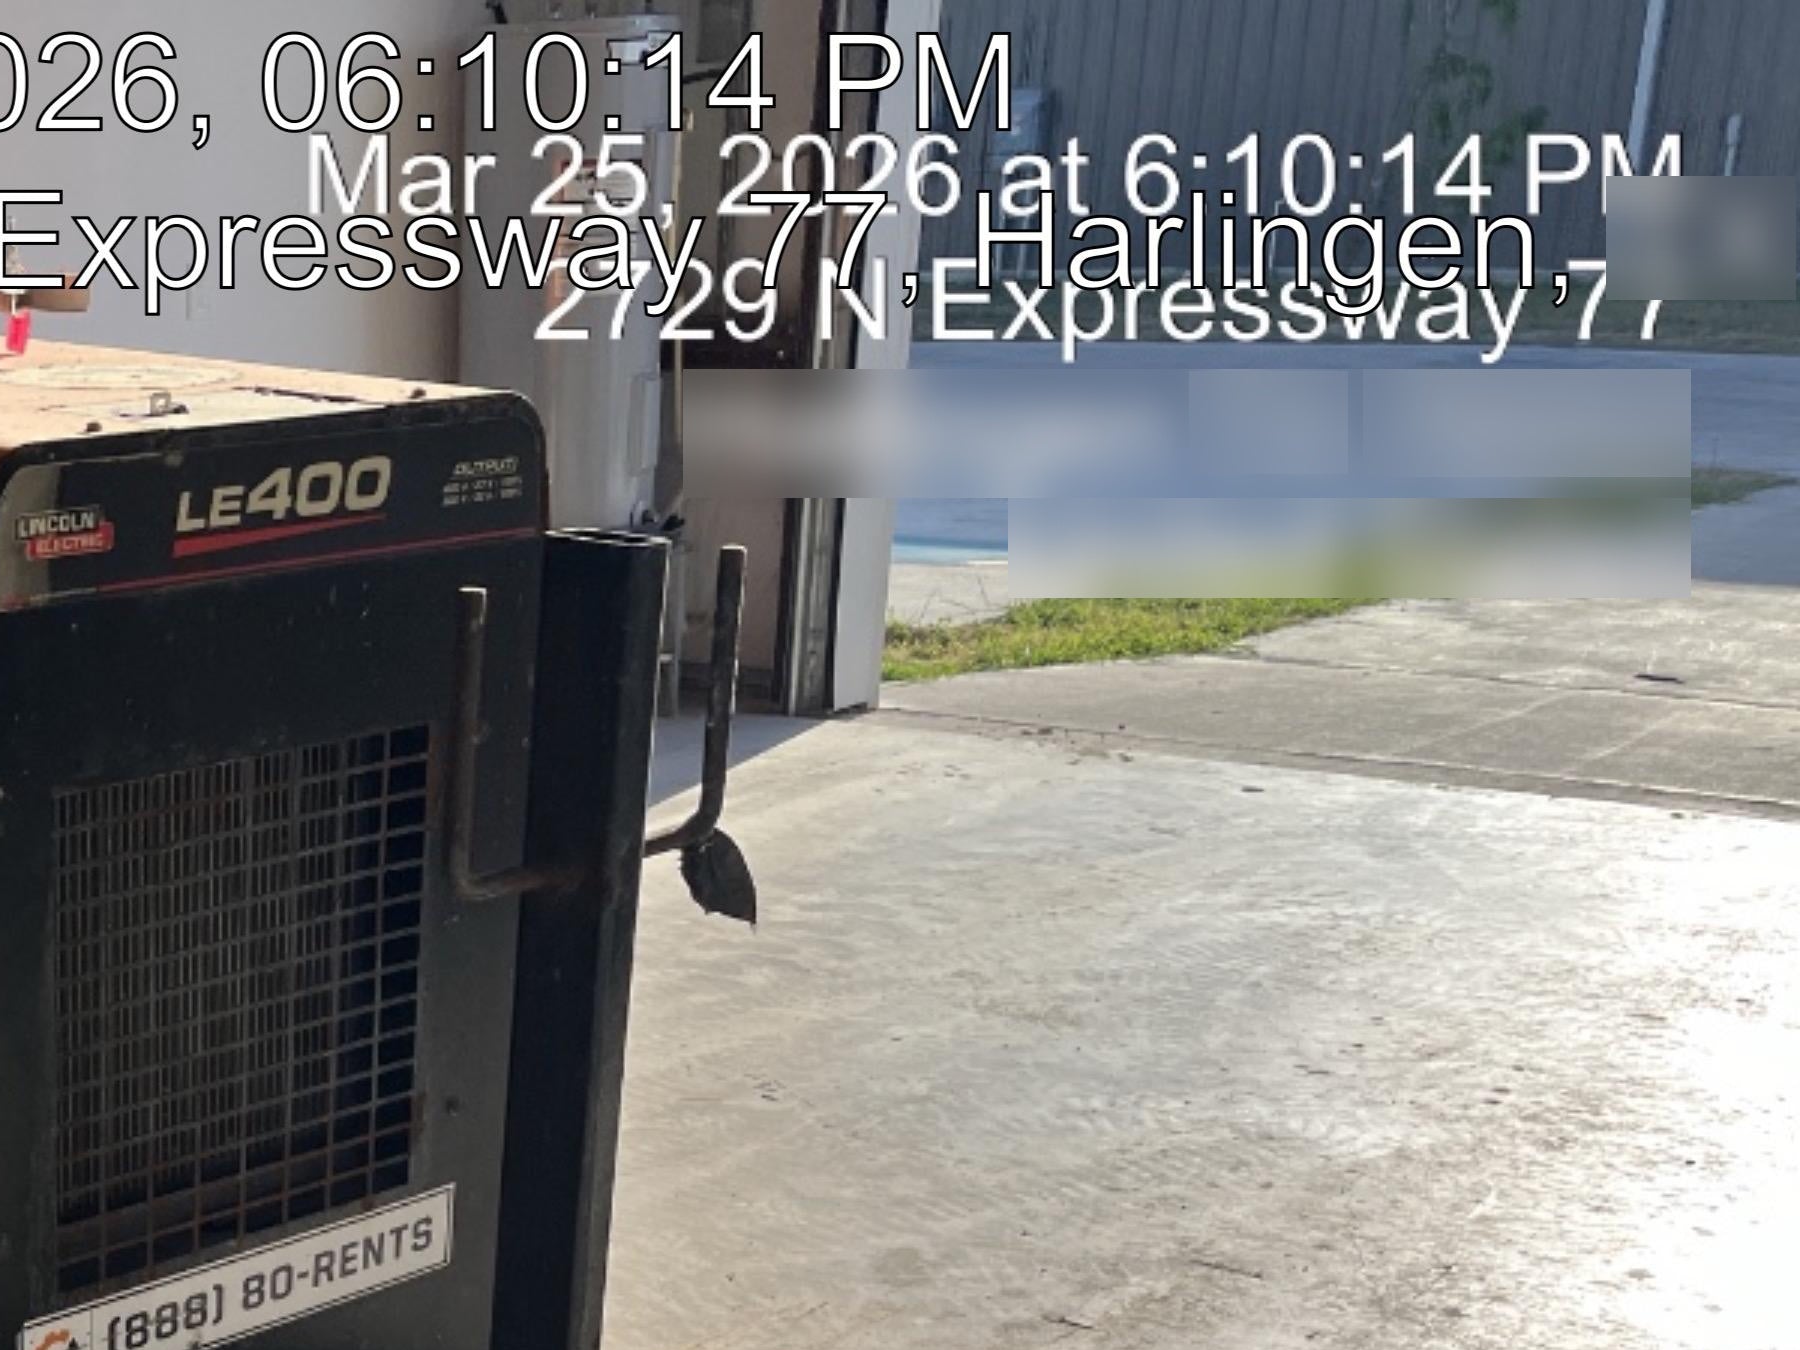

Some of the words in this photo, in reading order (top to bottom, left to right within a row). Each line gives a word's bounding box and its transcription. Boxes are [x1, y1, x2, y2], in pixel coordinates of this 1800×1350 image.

[18, 511, 96, 539] LINCOLN
[176, 456, 392, 532] LE400
[242, 1216, 433, 1311] 80-RENTS
